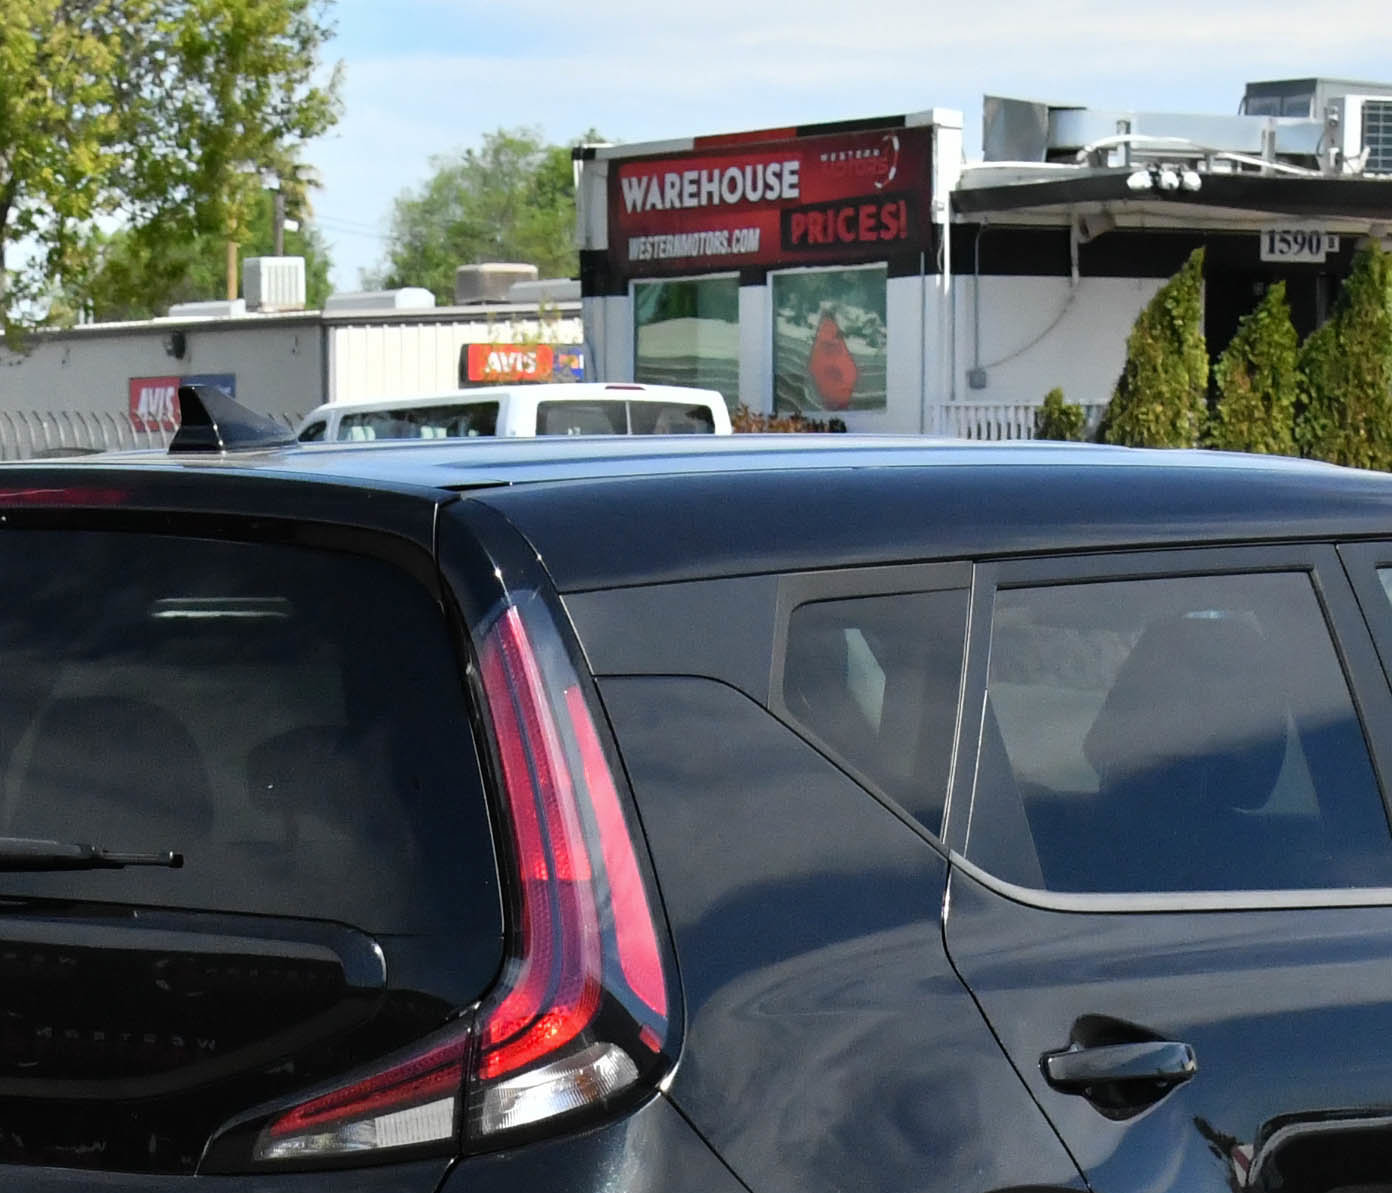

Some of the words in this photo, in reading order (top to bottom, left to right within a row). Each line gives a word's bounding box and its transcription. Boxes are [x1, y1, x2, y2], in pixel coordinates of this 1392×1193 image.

[621, 160, 800, 214] WAREHOUSE
[791, 201, 907, 244] PRICES!
[628, 228, 760, 260] WESTERNMOTORS.COM
[1268, 230, 1321, 255] 1590
[485, 351, 536, 373] AVIS
[138, 387, 175, 419] AVIS
